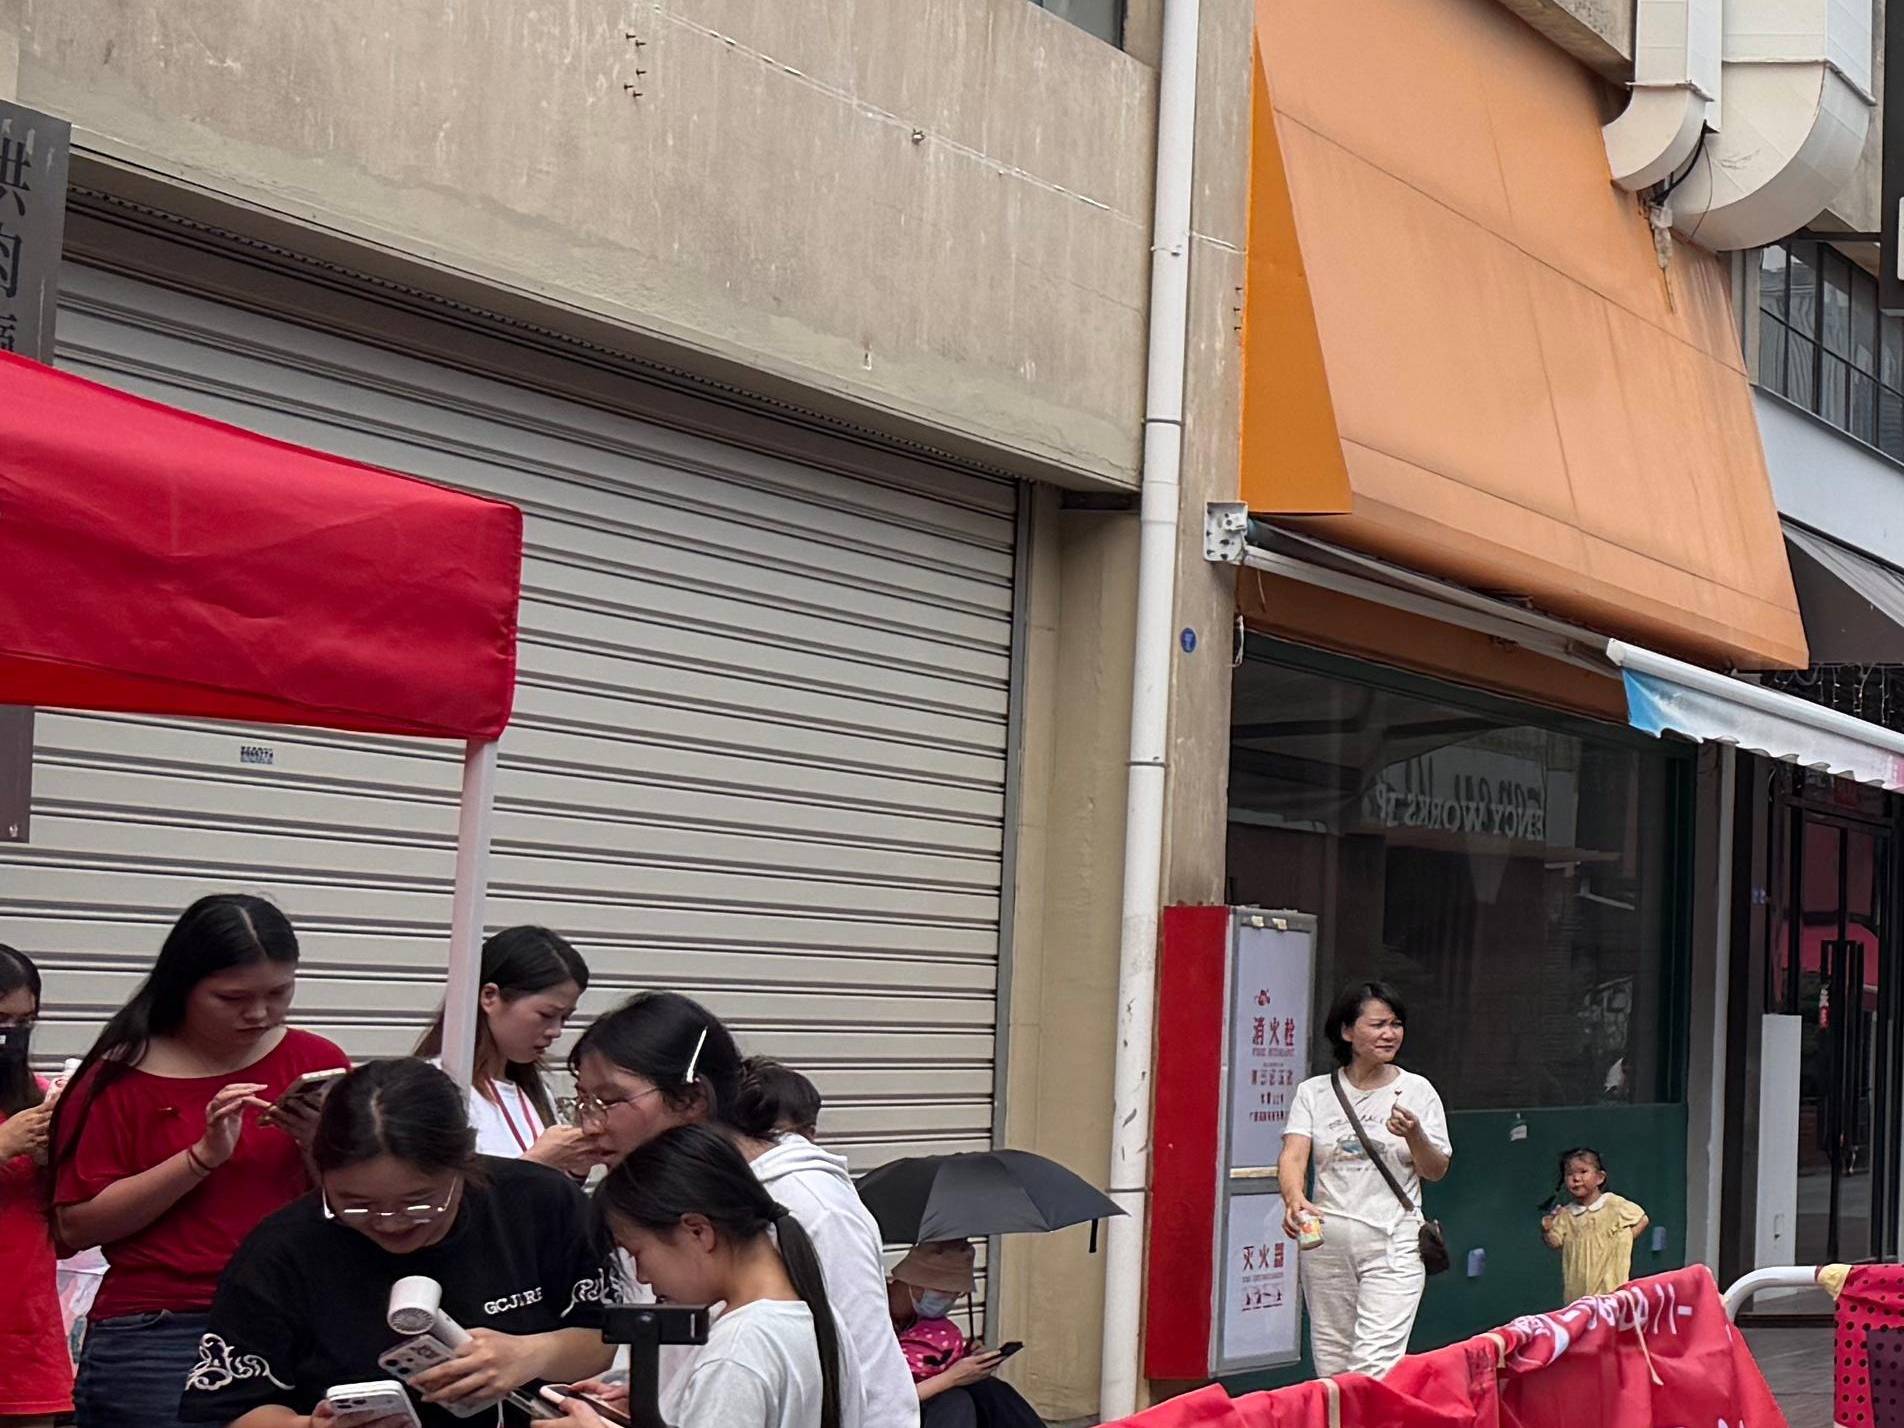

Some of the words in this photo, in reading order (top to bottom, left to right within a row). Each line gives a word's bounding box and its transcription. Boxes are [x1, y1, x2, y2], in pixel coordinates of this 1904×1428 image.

[1252, 1016, 1296, 1047] 消火栓
[1242, 1242, 1285, 1271] 灭火器
